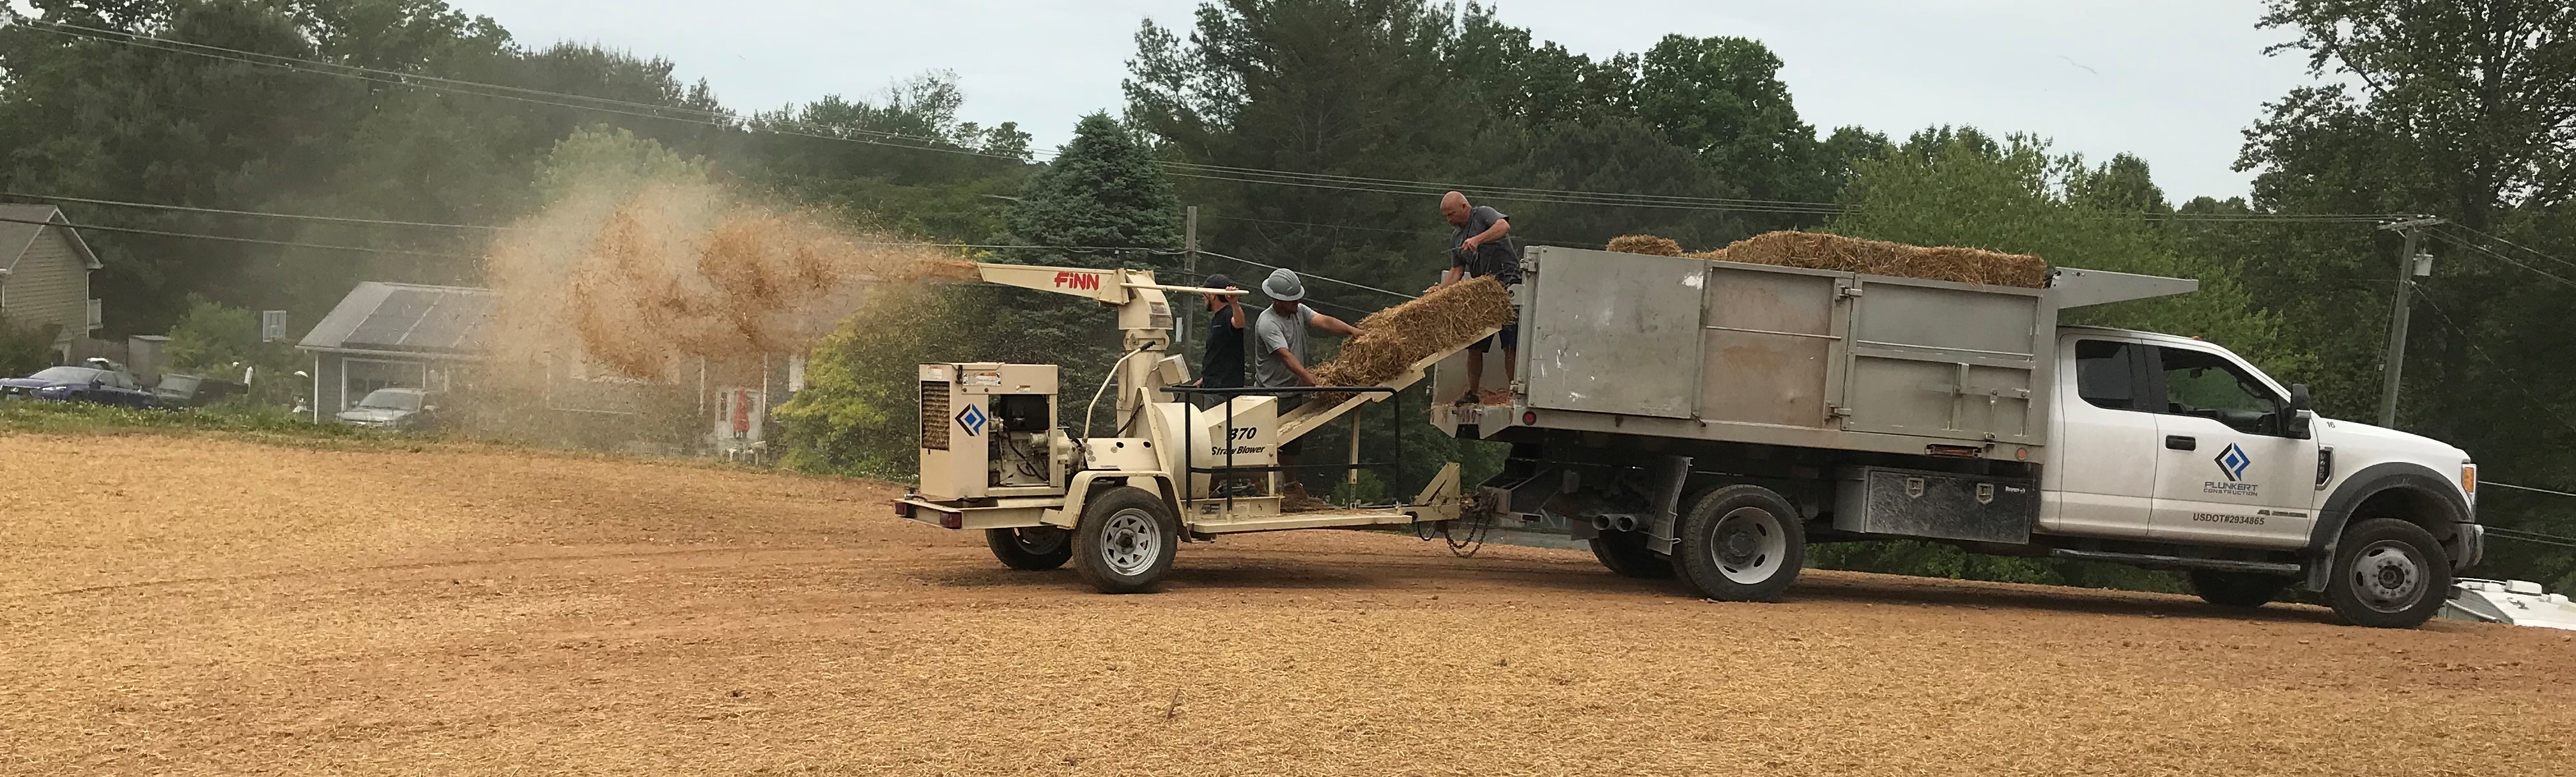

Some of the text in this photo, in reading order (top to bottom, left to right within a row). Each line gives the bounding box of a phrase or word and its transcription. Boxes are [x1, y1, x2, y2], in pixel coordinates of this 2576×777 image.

[1236, 445, 1265, 454] Blower
[2204, 481, 2258, 491] PLUNKERT
[2203, 488, 2258, 496] CONSTRUCTION
[2193, 512, 2265, 525] USDOT#2934865
